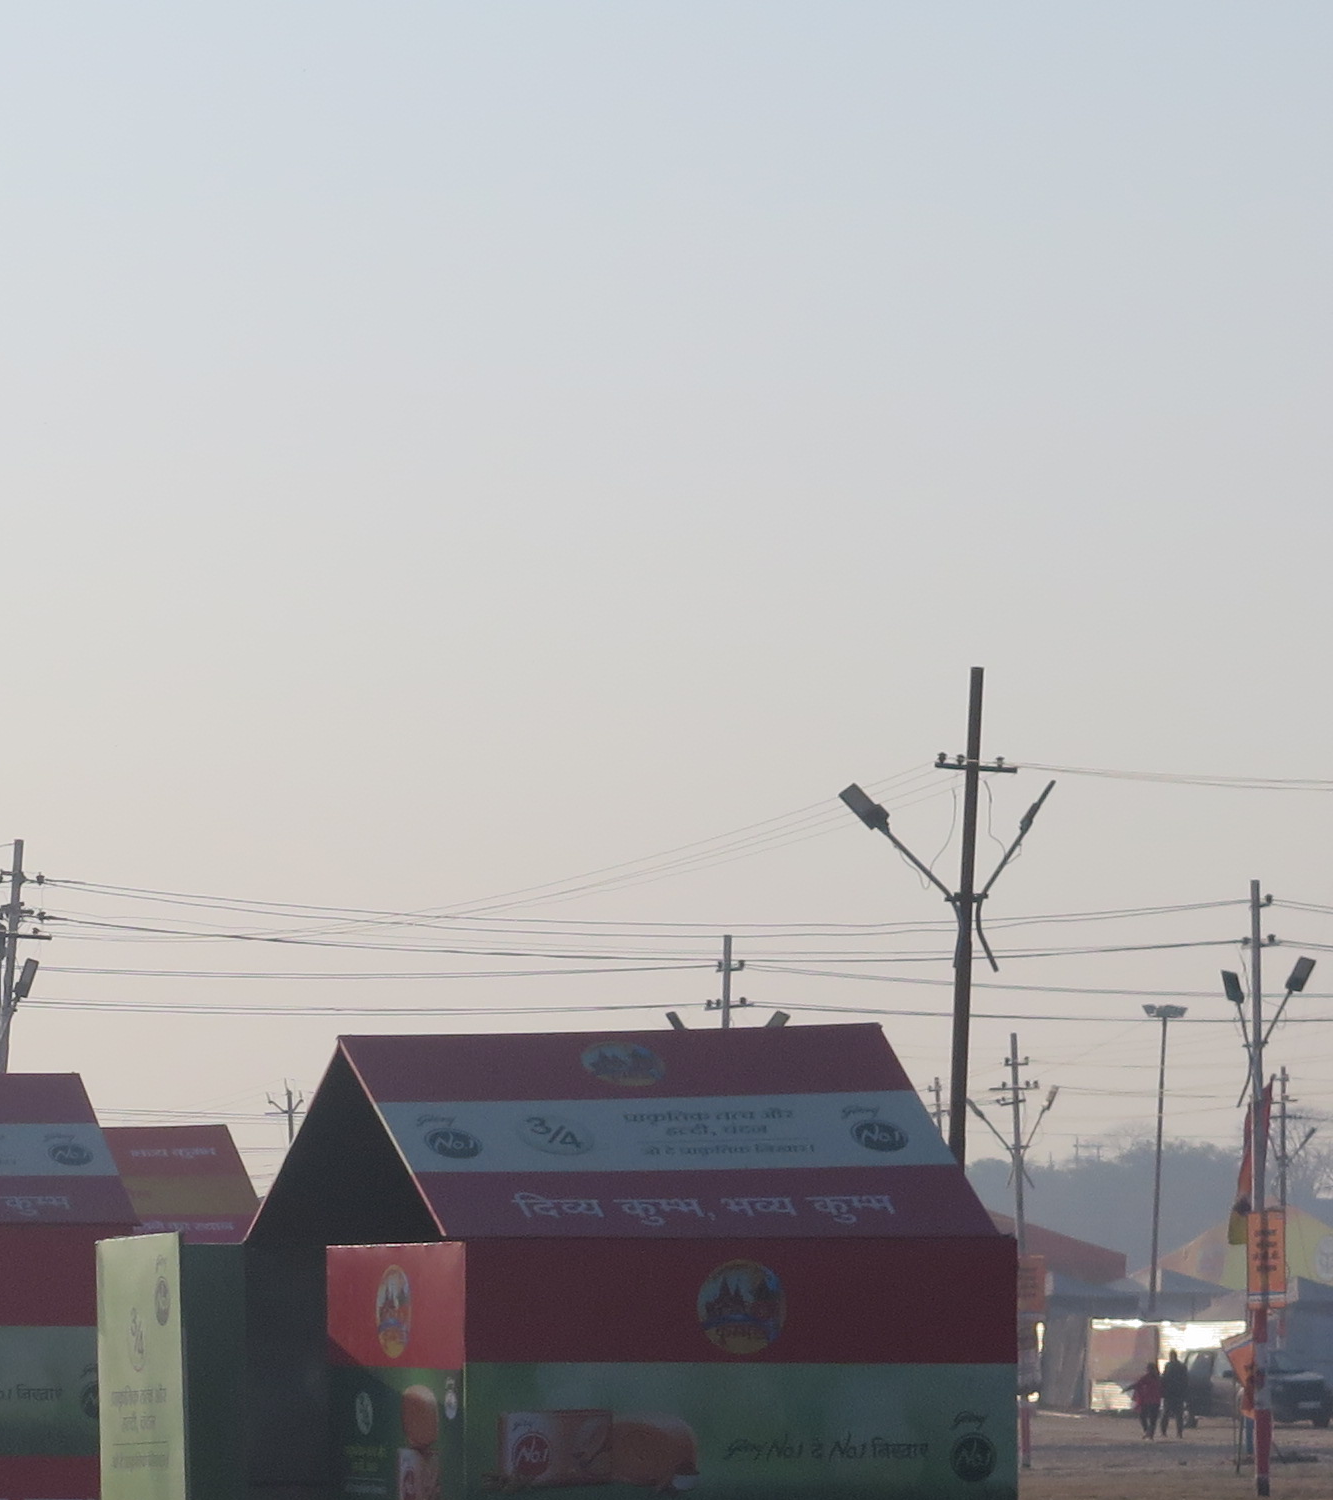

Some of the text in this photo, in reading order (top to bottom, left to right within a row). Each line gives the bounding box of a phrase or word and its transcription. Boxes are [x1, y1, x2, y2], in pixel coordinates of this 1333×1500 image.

[526, 1116, 582, 1149] 3/4
[0, 1194, 69, 1215] कुम्भ
[513, 1193, 895, 1225] दिव्य कुम्भ, भव्य कुम्भ
